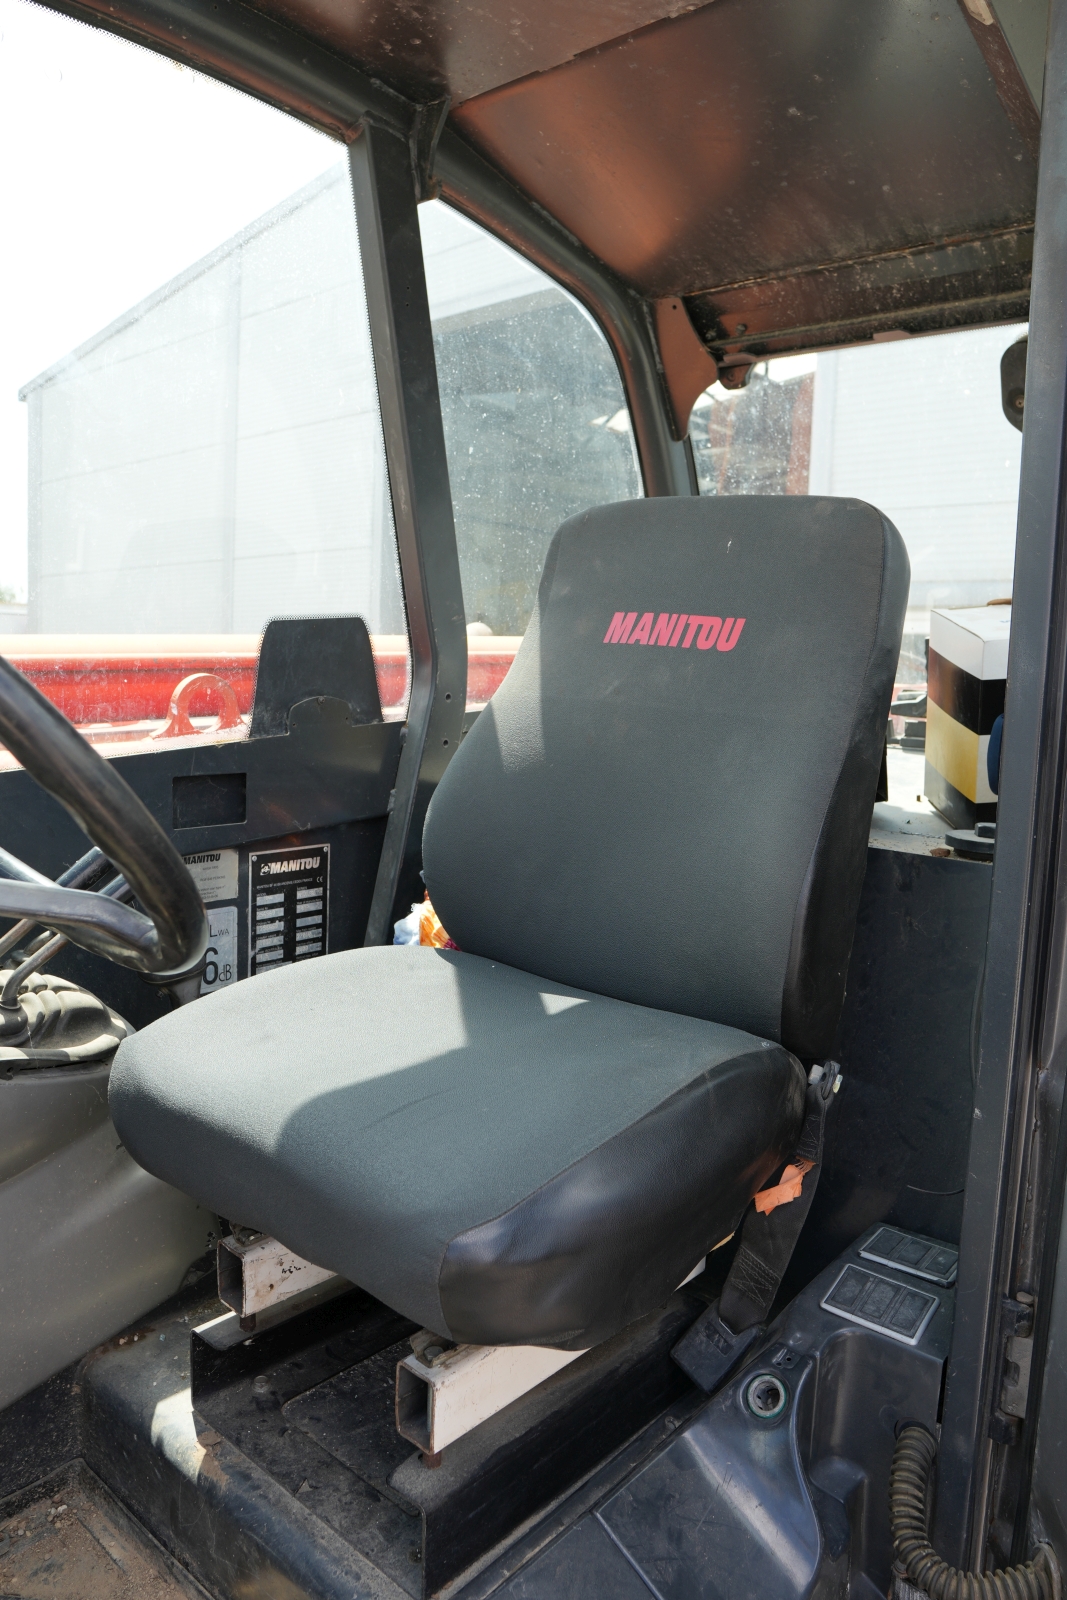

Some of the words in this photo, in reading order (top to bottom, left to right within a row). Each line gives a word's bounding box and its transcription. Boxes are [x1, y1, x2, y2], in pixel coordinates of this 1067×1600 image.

[603, 611, 746, 652] MANITOU
[182, 853, 221, 865] MANITOU
[270, 857, 321, 875] MANITOU
